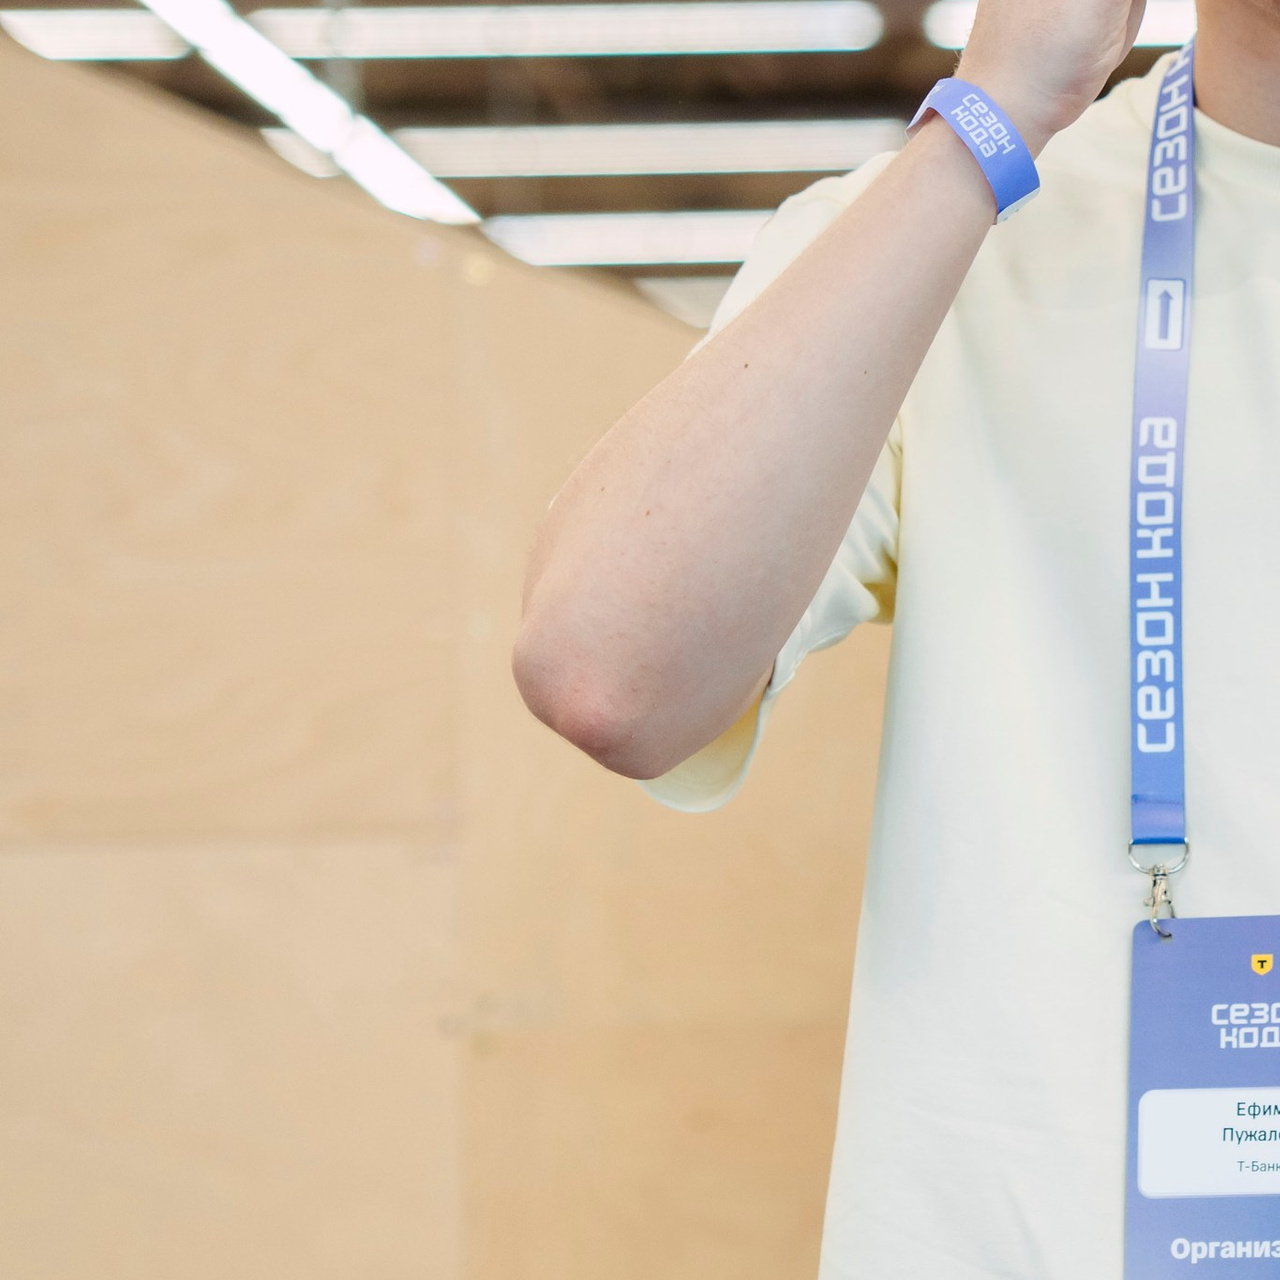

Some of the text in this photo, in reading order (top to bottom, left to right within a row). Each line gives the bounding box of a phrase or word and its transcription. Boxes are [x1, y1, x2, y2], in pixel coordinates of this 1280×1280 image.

[950, 105, 998, 158] кода
[961, 93, 1017, 155] сезон
[1151, 73, 1190, 222] сезон
[1136, 416, 1178, 754] сезон кода
